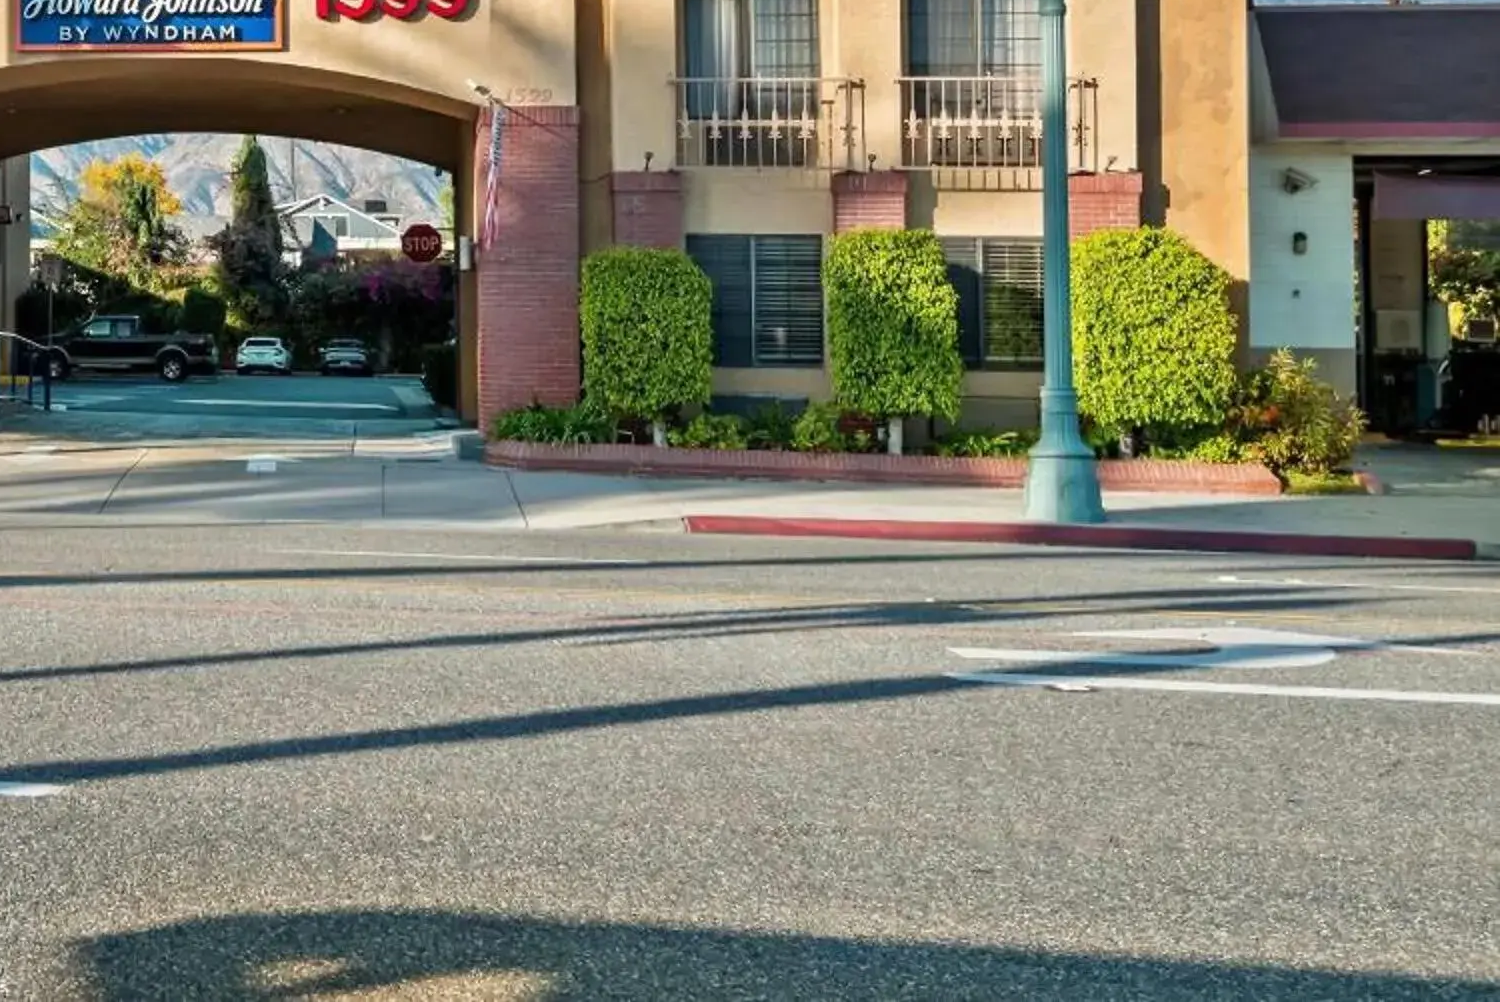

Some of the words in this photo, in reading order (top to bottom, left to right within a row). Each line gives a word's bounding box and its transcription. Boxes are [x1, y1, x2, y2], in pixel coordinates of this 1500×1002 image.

[59, 25, 89, 41] BY
[103, 24, 236, 41] WYNDHAM
[402, 235, 440, 252] STOP
